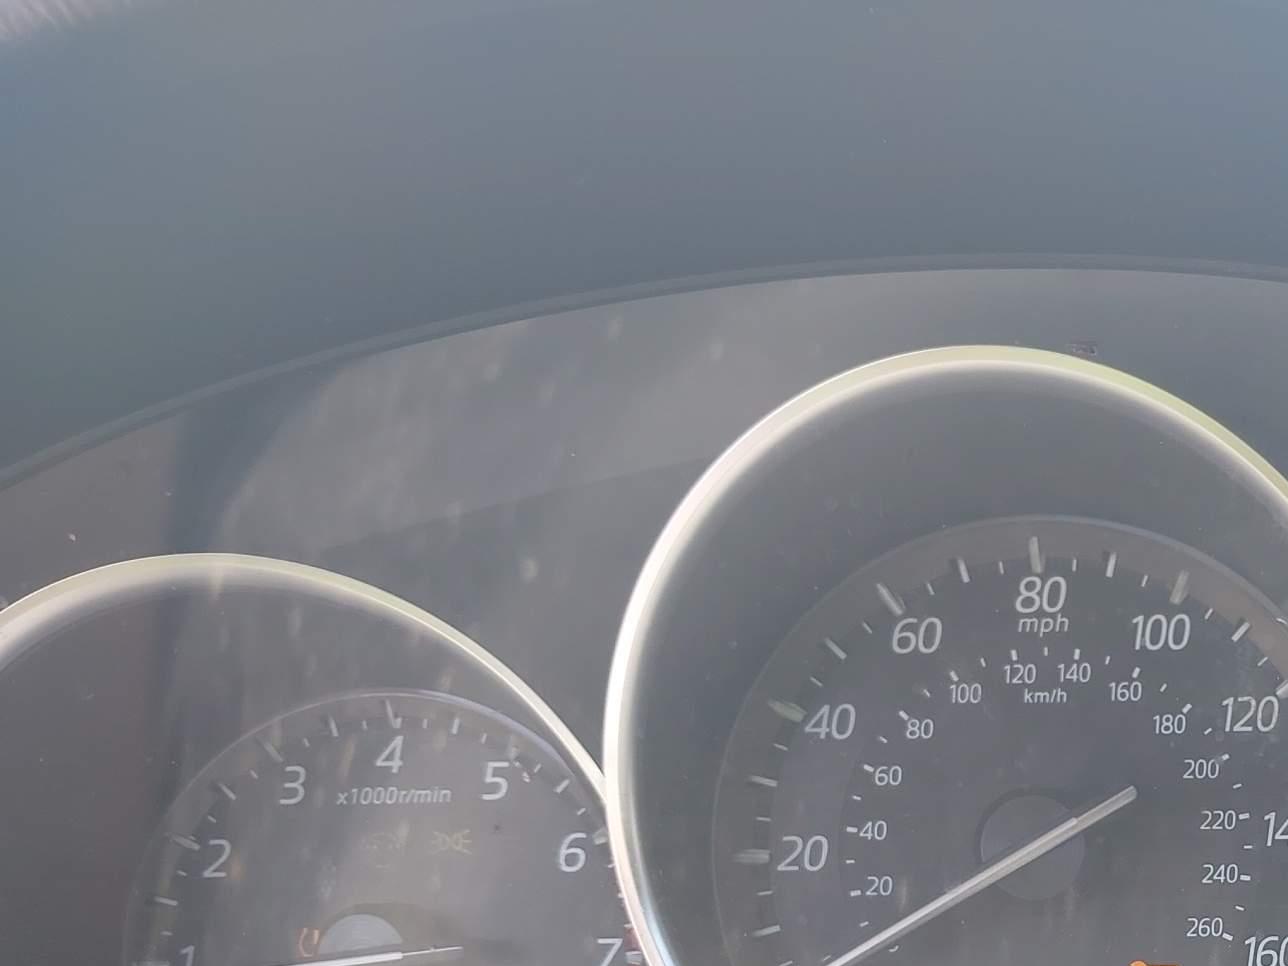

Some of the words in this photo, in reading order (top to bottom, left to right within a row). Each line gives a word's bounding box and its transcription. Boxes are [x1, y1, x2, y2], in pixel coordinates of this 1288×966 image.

[1015, 576, 1067, 614] 80
[891, 617, 943, 654] 60
[1017, 613, 1069, 637] mph
[1131, 613, 1191, 651] 100
[1004, 664, 1037, 684] 120
[1057, 663, 1091, 683] 140
[949, 683, 982, 704] 100
[1024, 688, 1067, 704] km/h
[1108, 681, 1142, 702] 160
[804, 703, 856, 740] 40
[1152, 714, 1187, 735] 180
[1221, 696, 1280, 733] 120
[905, 719, 934, 740] 80
[375, 735, 404, 774] 4
[874, 765, 902, 786] 60
[1182, 759, 1220, 779] 200
[279, 765, 307, 805] 3
[481, 761, 510, 801] 5
[858, 820, 887, 841] 40
[1199, 810, 1237, 830] 220
[202, 839, 231, 879] 2
[559, 831, 587, 873] 6
[777, 835, 829, 872] 20
[1201, 864, 1239, 884] 240
[865, 876, 893, 896] 20
[1186, 917, 1224, 938] 260
